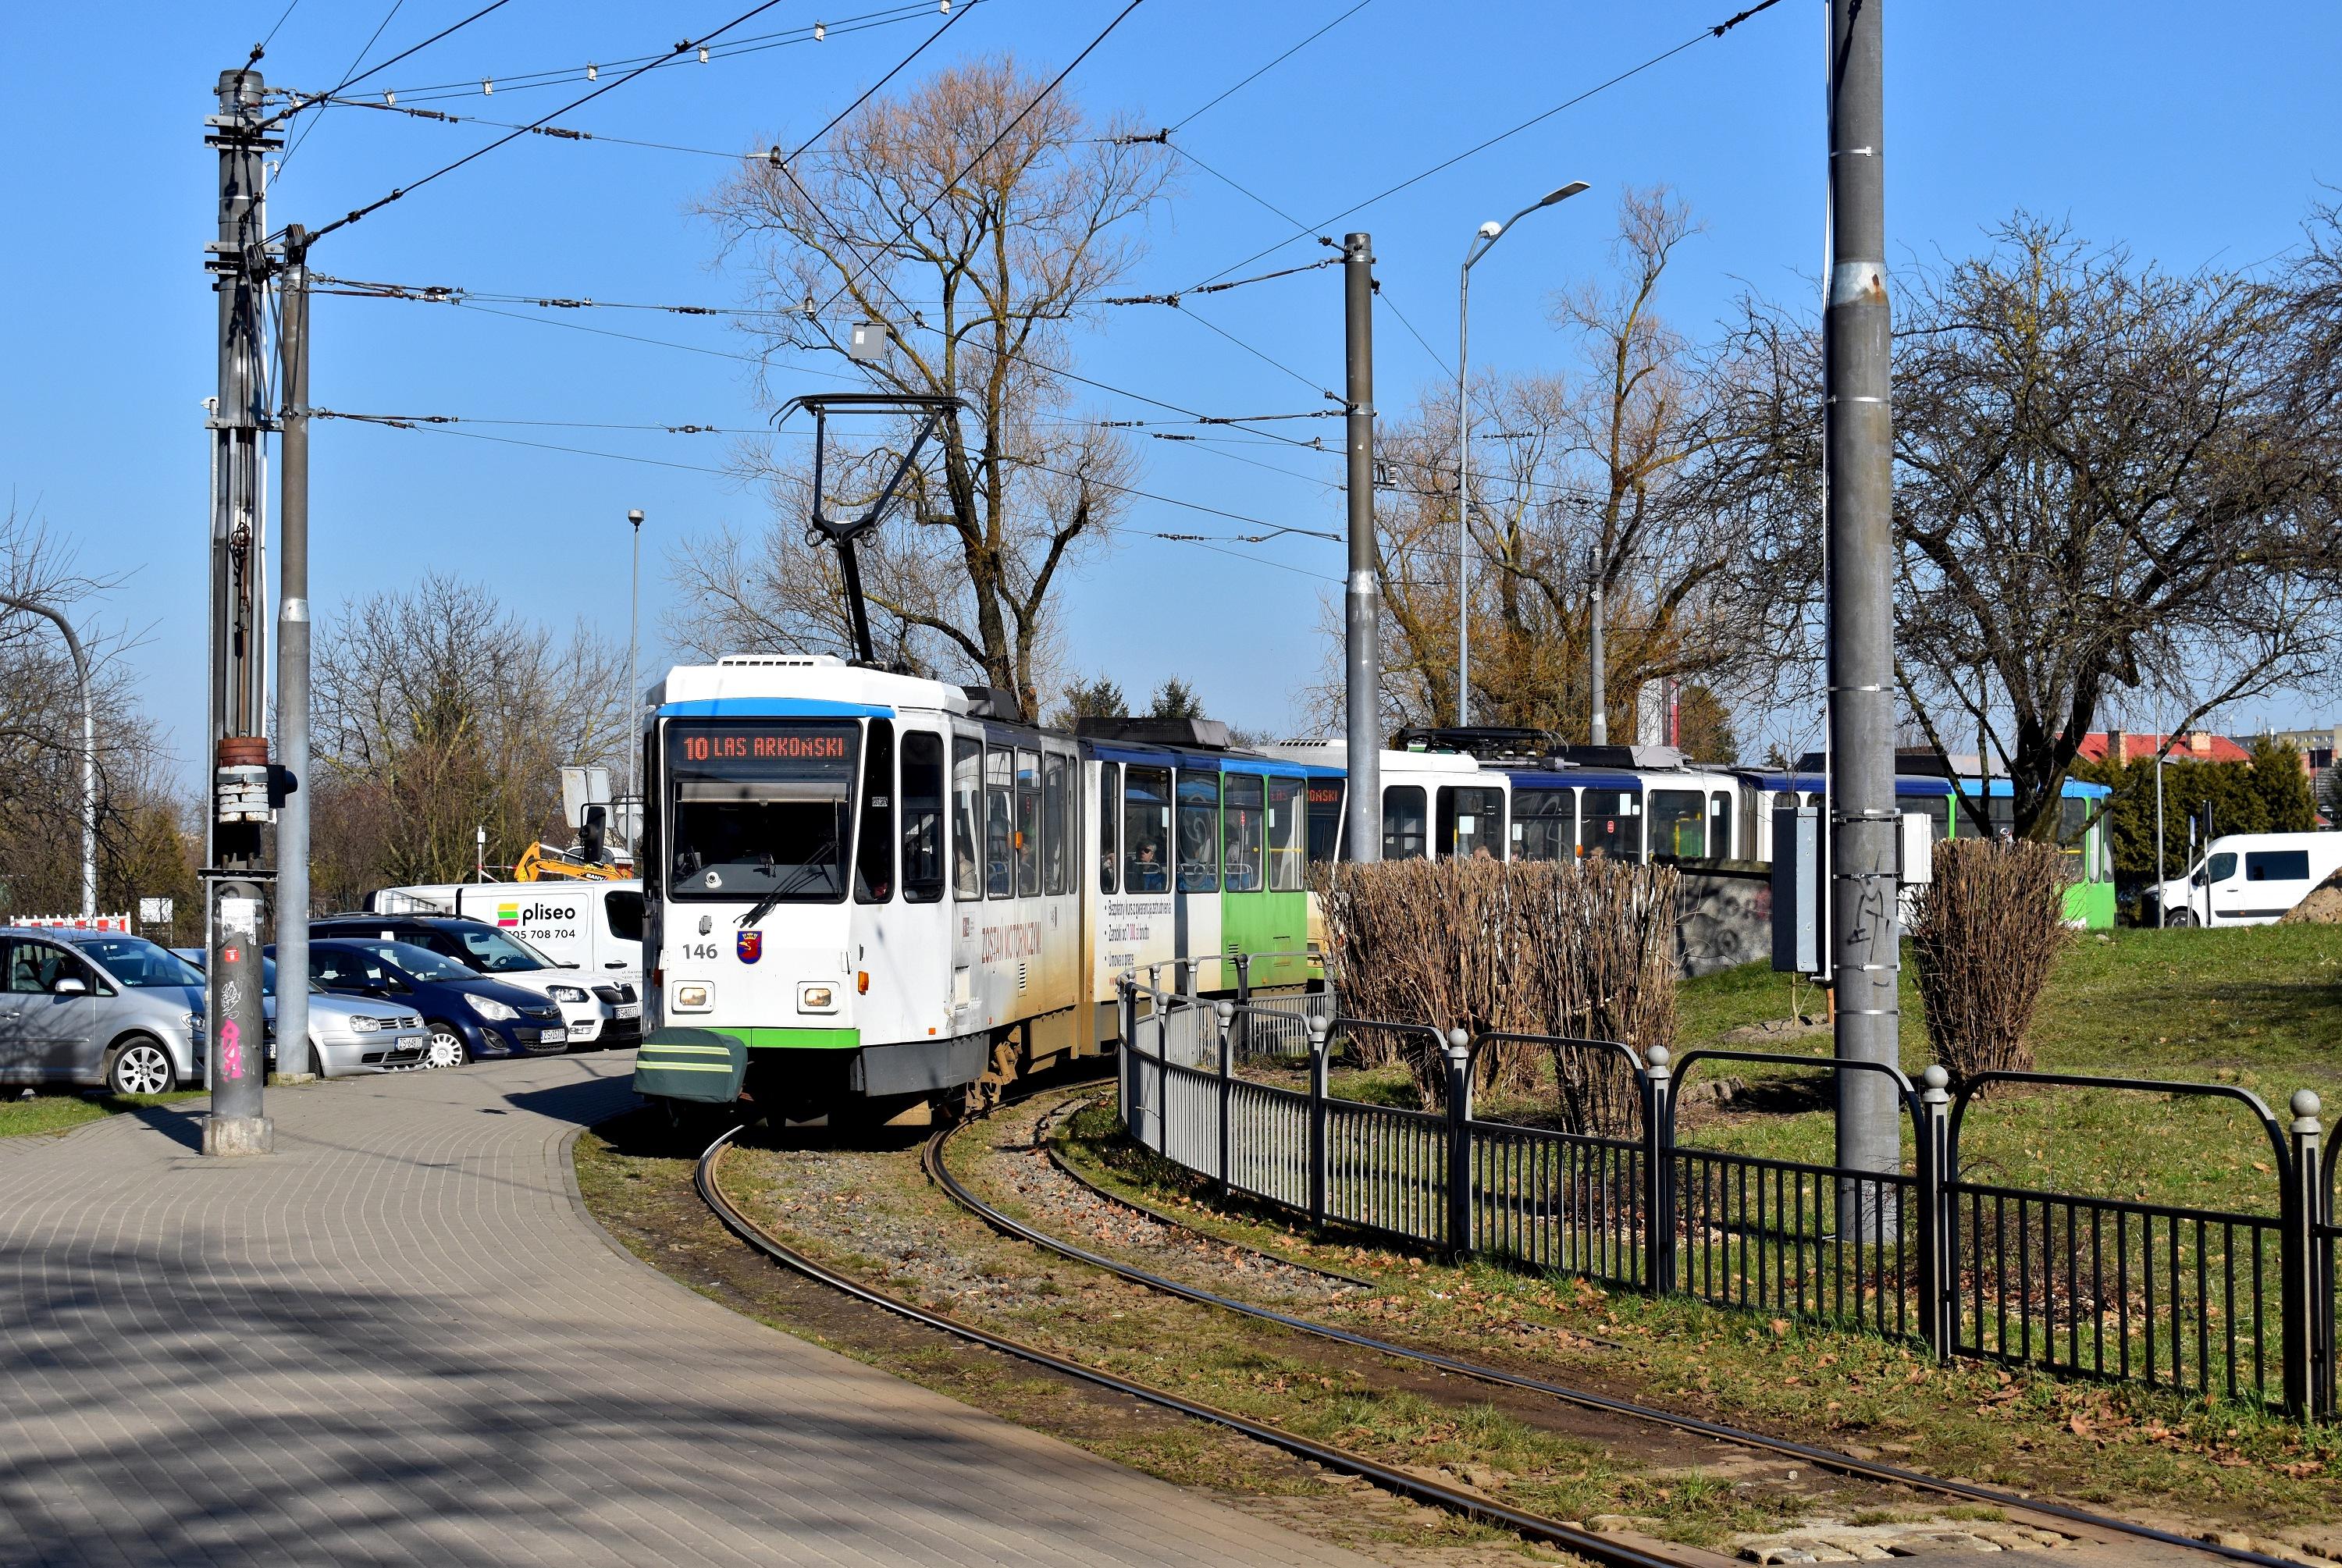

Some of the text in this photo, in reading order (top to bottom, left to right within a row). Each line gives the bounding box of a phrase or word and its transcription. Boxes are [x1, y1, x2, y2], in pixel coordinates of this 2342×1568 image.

[684, 737, 843, 760] 10 LAS ARKOŃSKI
[1306, 788, 1338, 802] OŃSKI
[522, 903, 576, 926] pliseo
[530, 930, 551, 939] 708
[554, 929, 576, 938] 704
[981, 916, 1004, 964] ZOSTAŃ
[682, 944, 718, 959] 146
